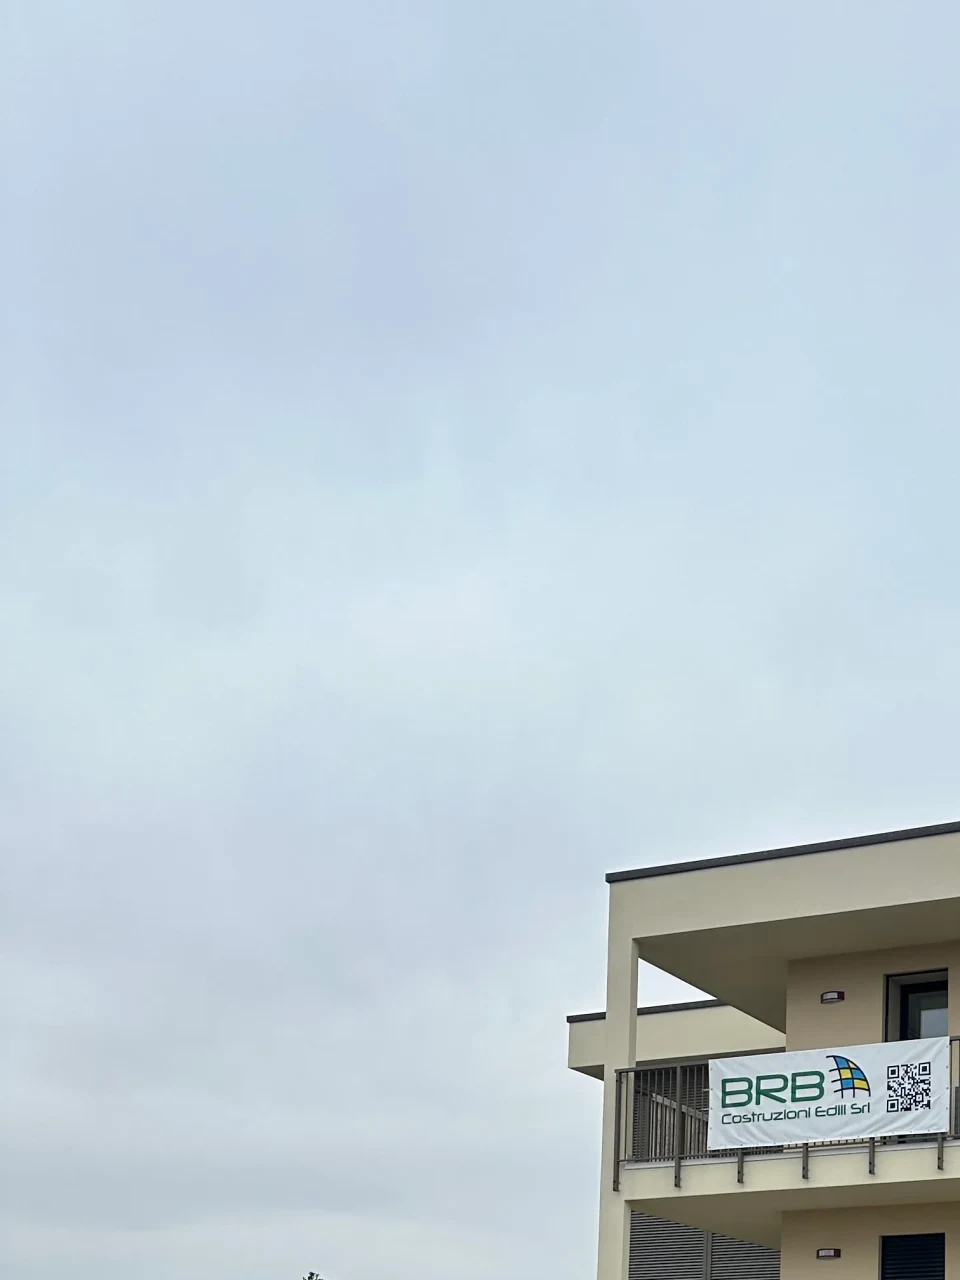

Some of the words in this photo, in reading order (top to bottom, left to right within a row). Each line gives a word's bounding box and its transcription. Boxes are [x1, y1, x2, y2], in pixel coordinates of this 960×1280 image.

[721, 1070, 825, 1108] BRB
[721, 1108, 811, 1125] Costruzioni
[815, 1104, 846, 1117] Edili
[850, 1102, 870, 1114] Srl
